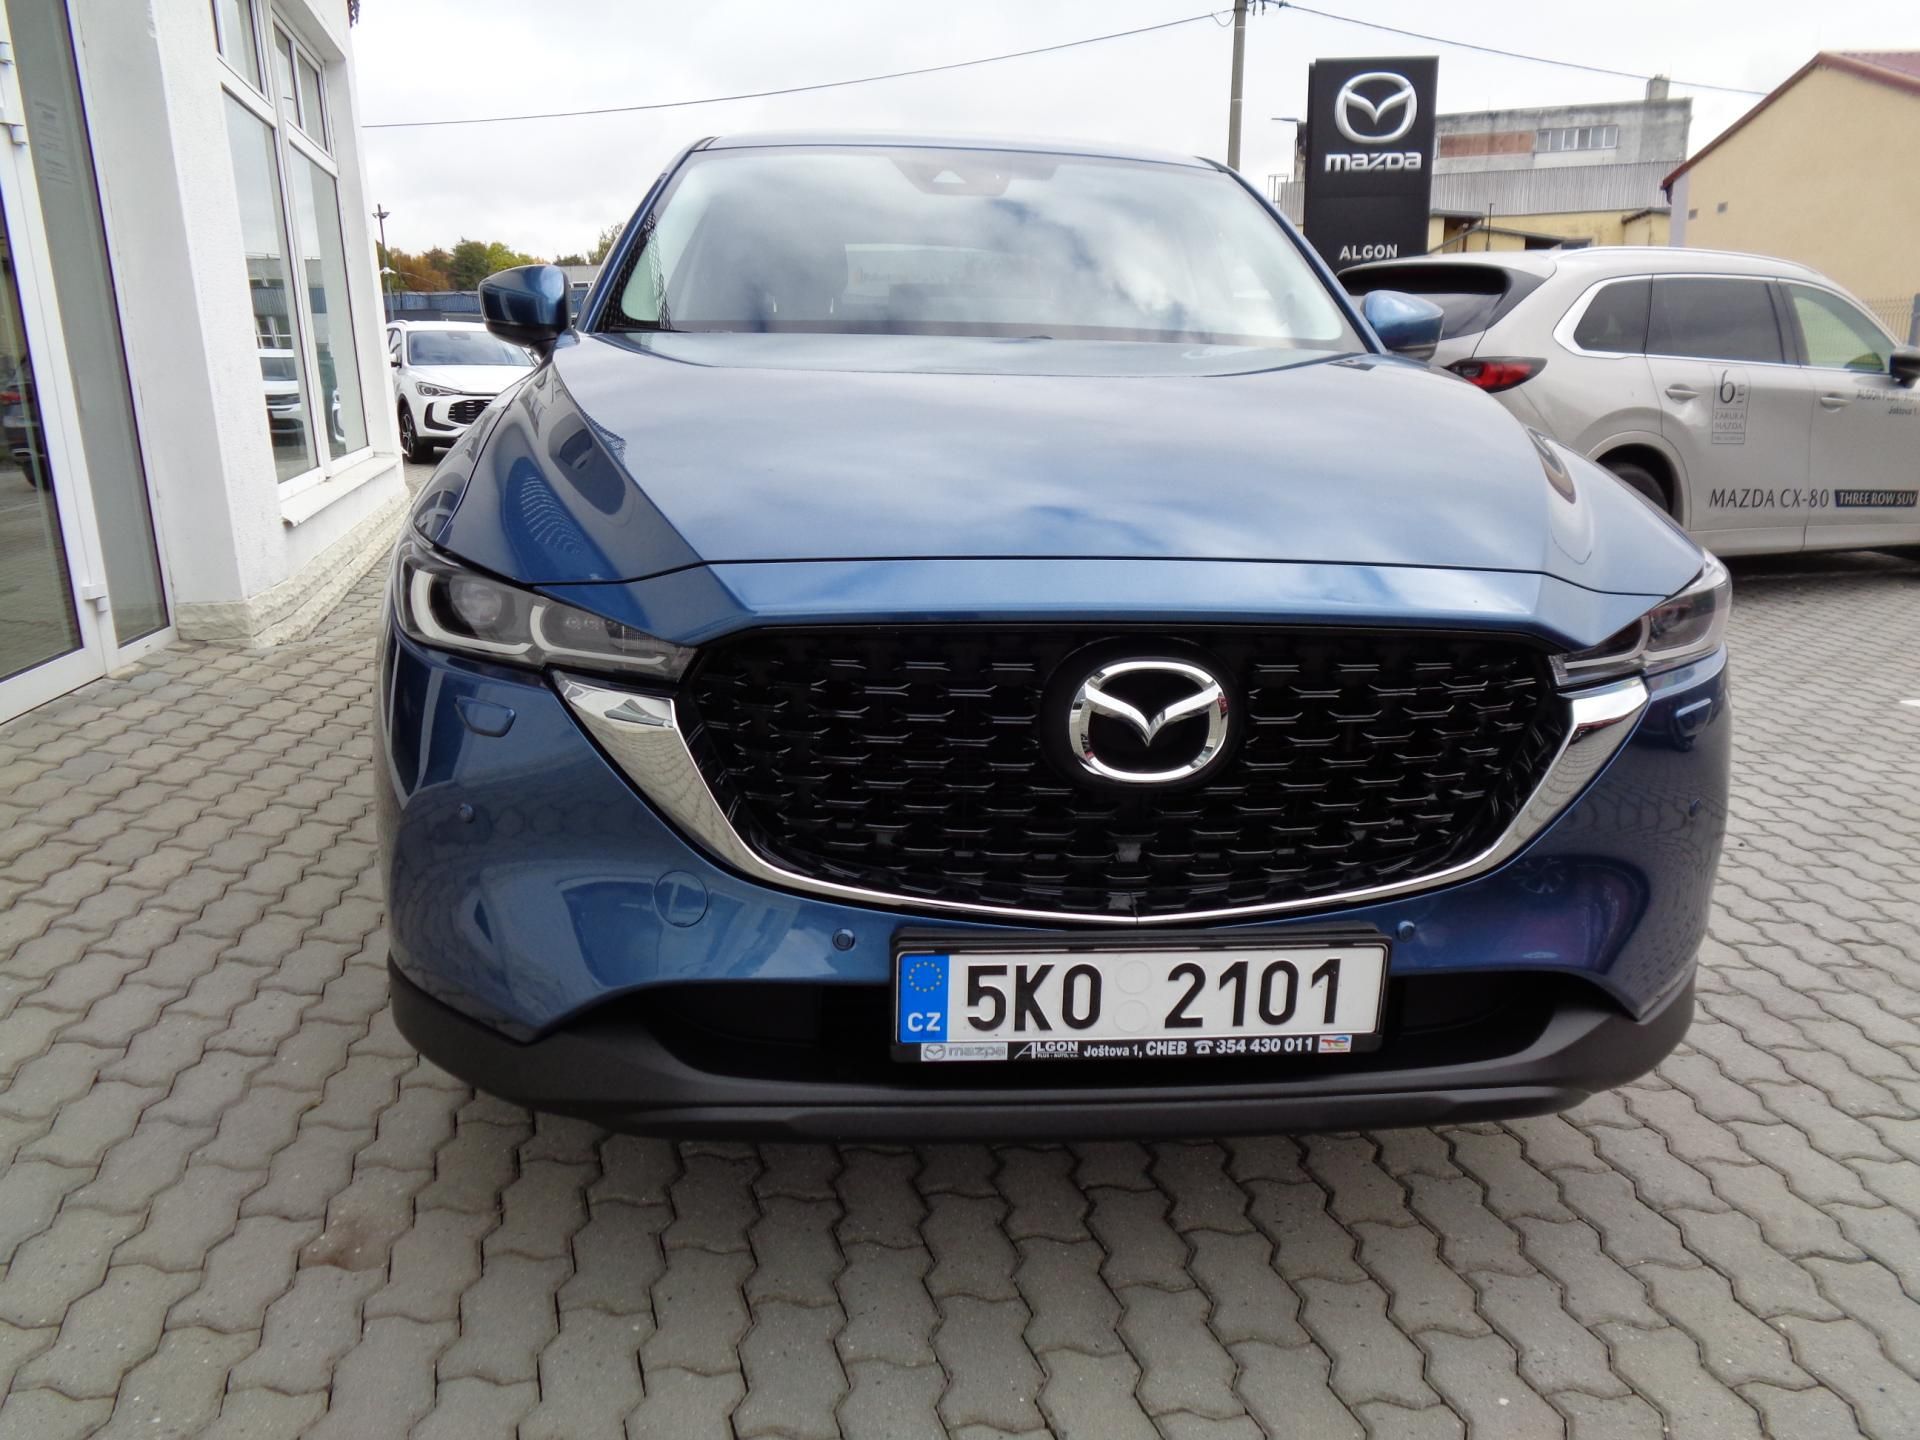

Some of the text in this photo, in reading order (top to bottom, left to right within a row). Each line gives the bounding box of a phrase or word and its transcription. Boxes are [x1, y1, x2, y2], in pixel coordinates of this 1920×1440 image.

[1324, 151, 1422, 172] mazda
[1339, 244, 1398, 260] ALGON
[1720, 369, 1736, 404] 6
[1709, 488, 1830, 508] MAZDA CX-80
[1840, 492, 1916, 505] THREE ROW SUV
[967, 958, 1343, 1031] 5K0 2101
[907, 1012, 941, 1031] CZ
[1014, 1041, 1079, 1059] ALGON
[1083, 1037, 1313, 1058] Joštova 1, CHEB 354 430 011
